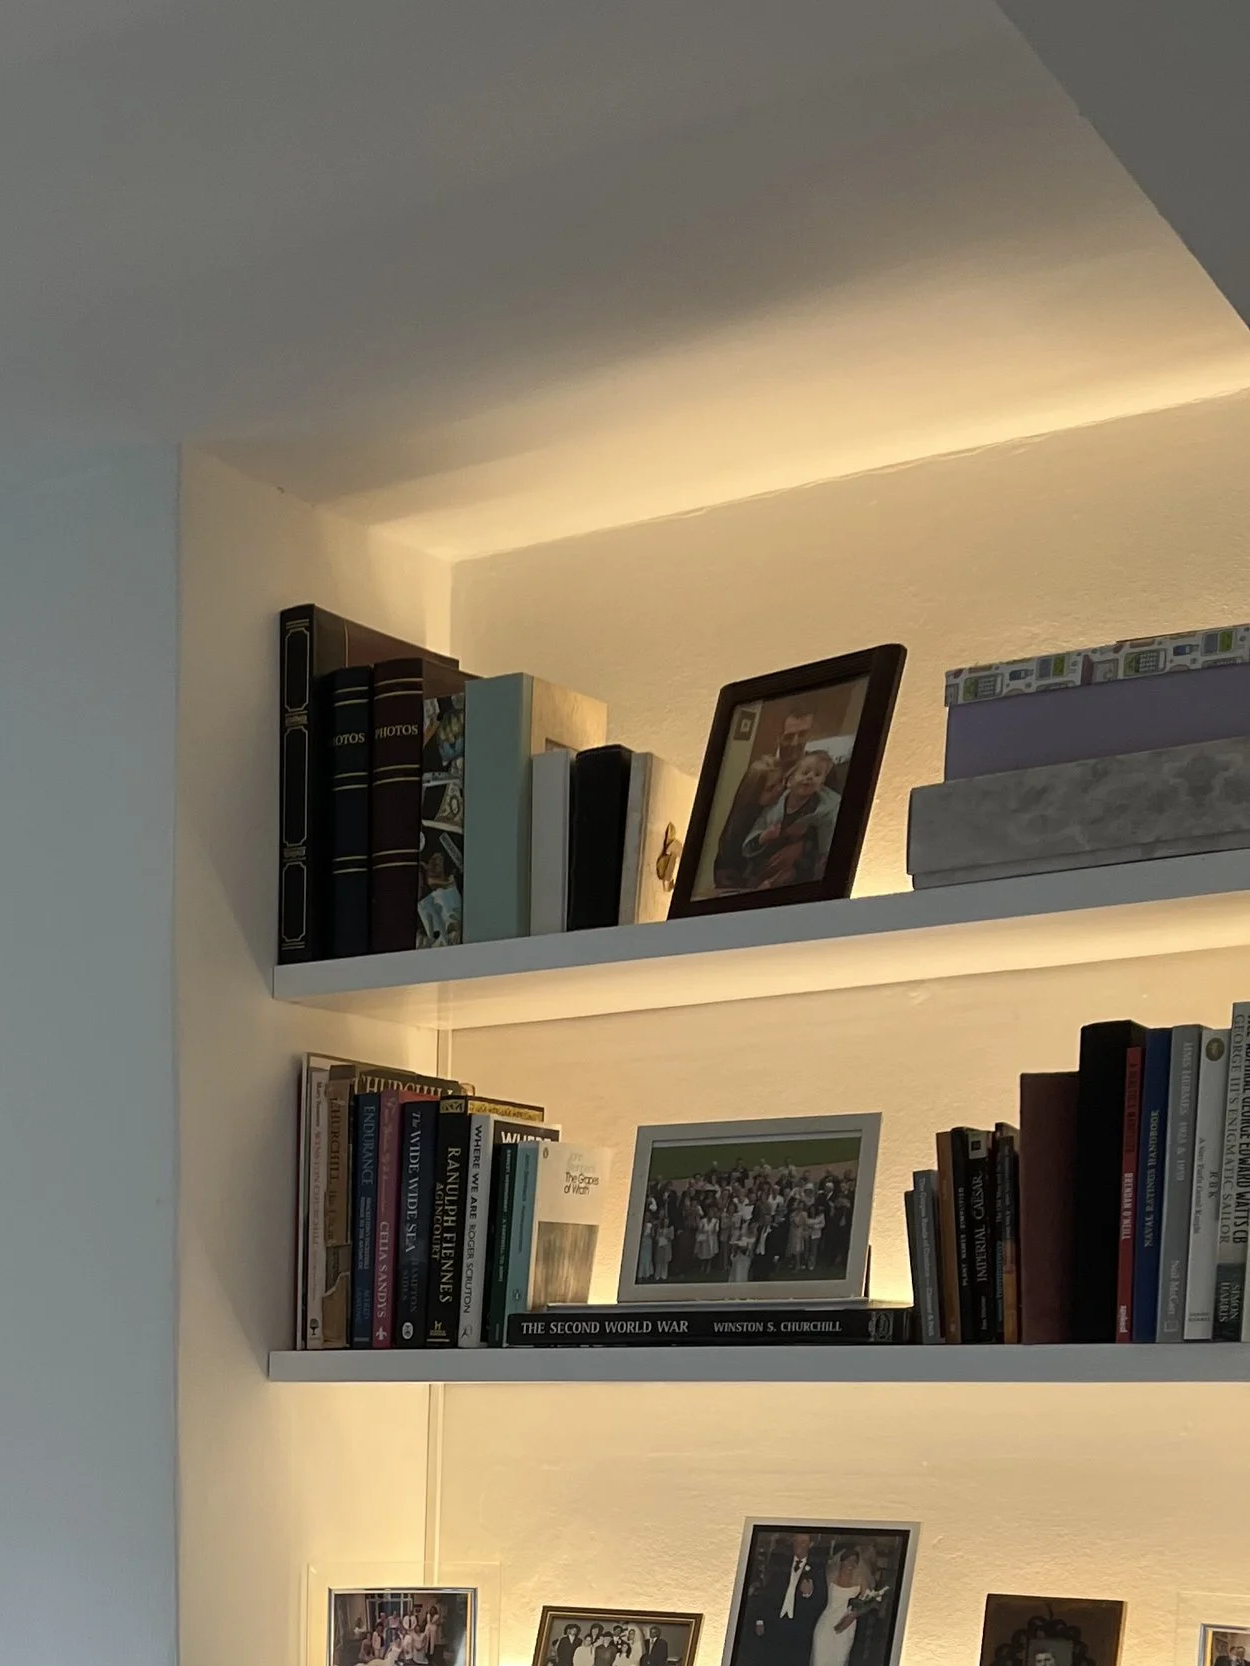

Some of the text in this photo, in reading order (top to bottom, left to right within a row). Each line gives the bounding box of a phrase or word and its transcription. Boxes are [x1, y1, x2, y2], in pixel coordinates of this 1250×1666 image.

[335, 733, 365, 746] OTOS
[375, 724, 418, 740] PHOTOS
[1232, 1014, 1244, 1072] GEORGE
[361, 1105, 376, 1185] ENDURANCE
[408, 1130, 422, 1174] WIDE
[1224, 1109, 1238, 1191] ENIGMATIC
[1237, 1143, 1250, 1188] EDWARD
[469, 1125, 483, 1221] WHERE WE ARE
[563, 1184, 590, 1195] of Wrath
[565, 1172, 600, 1186] The Grapes
[406, 1177, 420, 1220] WIDE
[1219, 1193, 1231, 1244] SAILOR
[1234, 1191, 1250, 1227] WATTS
[378, 1221, 390, 1260] CELIA
[405, 1223, 418, 1252] SEA
[431, 1182, 445, 1260] AGINCOURT
[439, 1147, 462, 1303] RANULPH FIENNES
[971, 1174, 988, 1282] IMPERIAL CAESAR
[1143, 1214, 1155, 1247] NAVAL
[1232, 1229, 1248, 1244] CB
[463, 1224, 476, 1313] ROGER SCRUTON
[377, 1264, 388, 1318] SANDYS
[1219, 1282, 1230, 1322] HARRIS
[1230, 1284, 1240, 1320] SIMON
[522, 1320, 843, 1334] THE SECOND WORLD WAR WINSTON S. CHURCHILL
